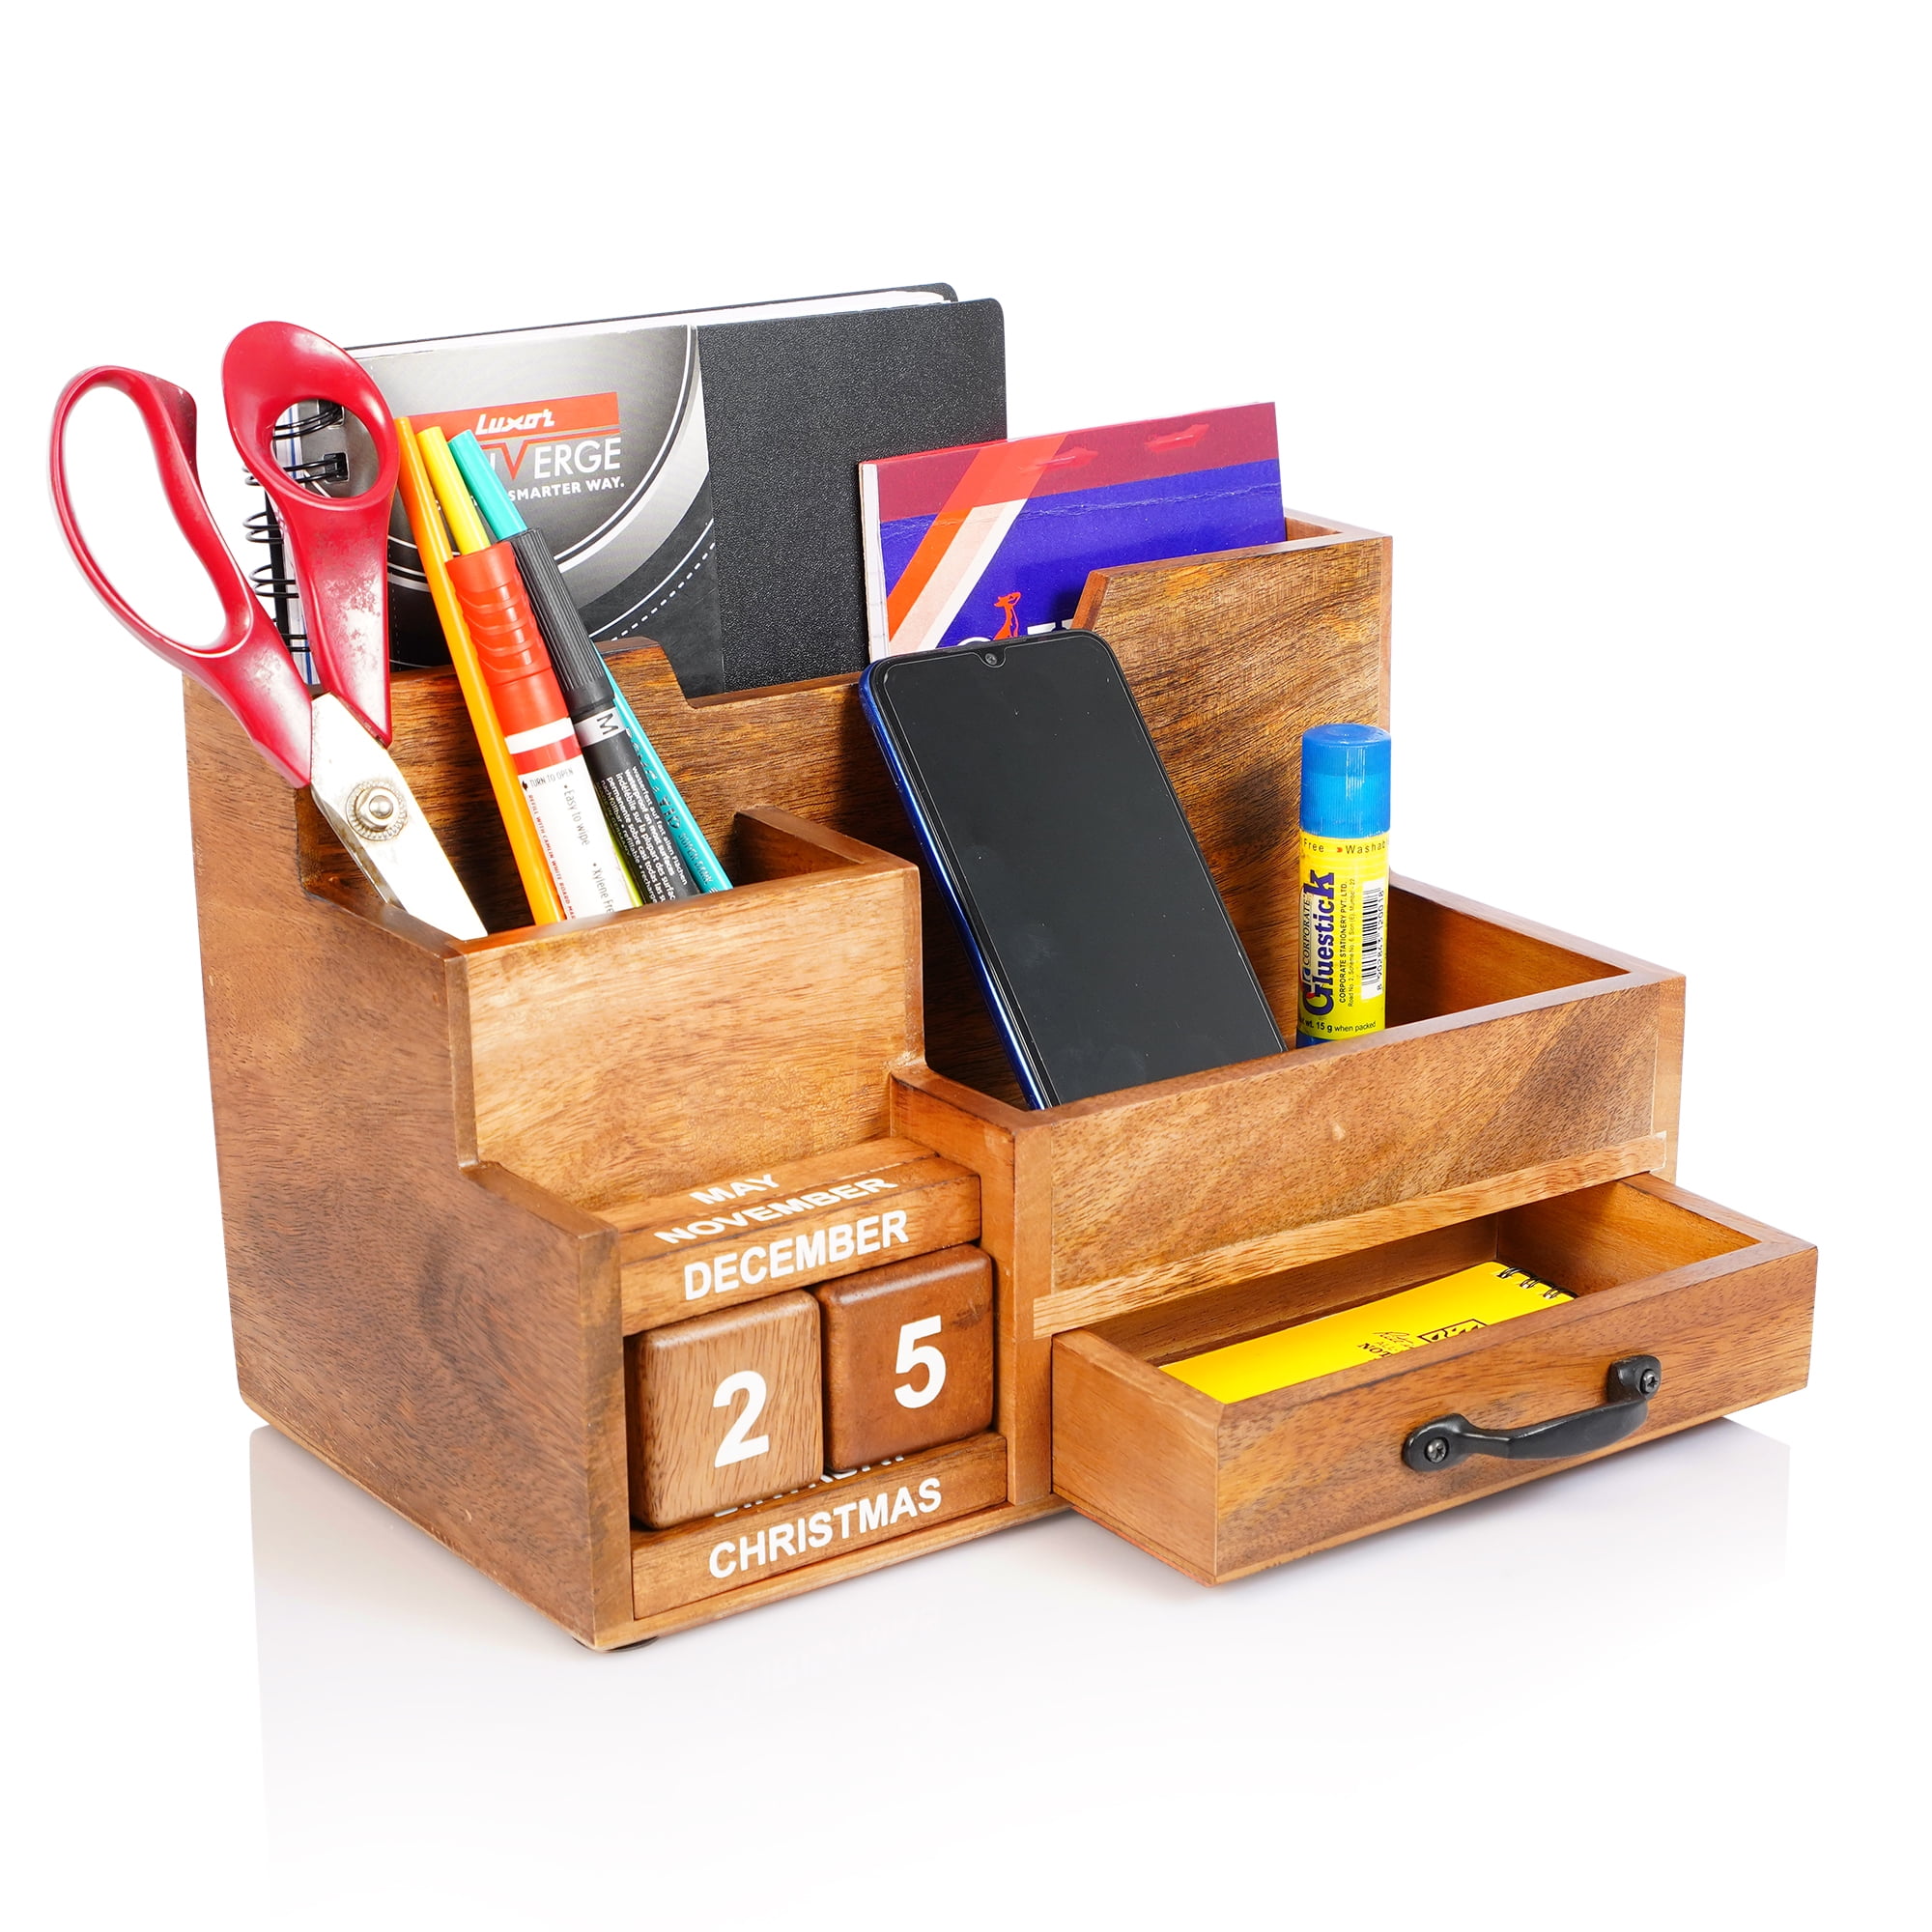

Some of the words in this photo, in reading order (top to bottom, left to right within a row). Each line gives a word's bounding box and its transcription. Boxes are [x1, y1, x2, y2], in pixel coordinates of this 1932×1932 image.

[508, 481, 582, 501] SMARTER
[585, 476, 624, 492] WAY.
[597, 713, 619, 735] M
[529, 776, 547, 788] TURN
[547, 773, 555, 783] TO
[555, 767, 574, 781] OPEN
[564, 788, 578, 810] Easy
[572, 811, 582, 822] to
[576, 823, 590, 846] wipe
[607, 776, 632, 824] permanente
[628, 823, 641, 847] sobre
[638, 846, 649, 862] casi
[644, 860, 658, 883] todas
[615, 772, 637, 811] indélébile
[633, 811, 642, 825] sur
[640, 833, 660, 863] plupart
[655, 862, 666, 876] des
[624, 768, 648, 812] waterproof
[649, 825, 662, 844] most
[657, 844, 675, 876] surfaces
[632, 766, 653, 806] wasserfest
[663, 836, 674, 855] allen
[671, 855, 688, 886] Flächen
[528, 794, 539, 815] REFILL
[536, 816, 546, 834] WITH
[551, 861, 562, 881] WHITE
[559, 882, 570, 905] BOARD
[623, 829, 640, 864] refillable
[1304, 838, 1324, 852] Free
[589, 867, 609, 899] Xylene
[1302, 869, 1335, 1016] Gluestick
[1339, 914, 1348, 957] STATIONERY
[1317, 1021, 1325, 1031] 15
[1354, 1020, 1377, 1032] packed
[654, 1177, 898, 1244] NOVEMBER
[689, 1174, 780, 1206] MAY
[684, 1209, 909, 1300] DECEMBER
[894, 1315, 947, 1409] 5
[712, 1370, 770, 1468] 2
[709, 1478, 942, 1578] CHRISTMAS
